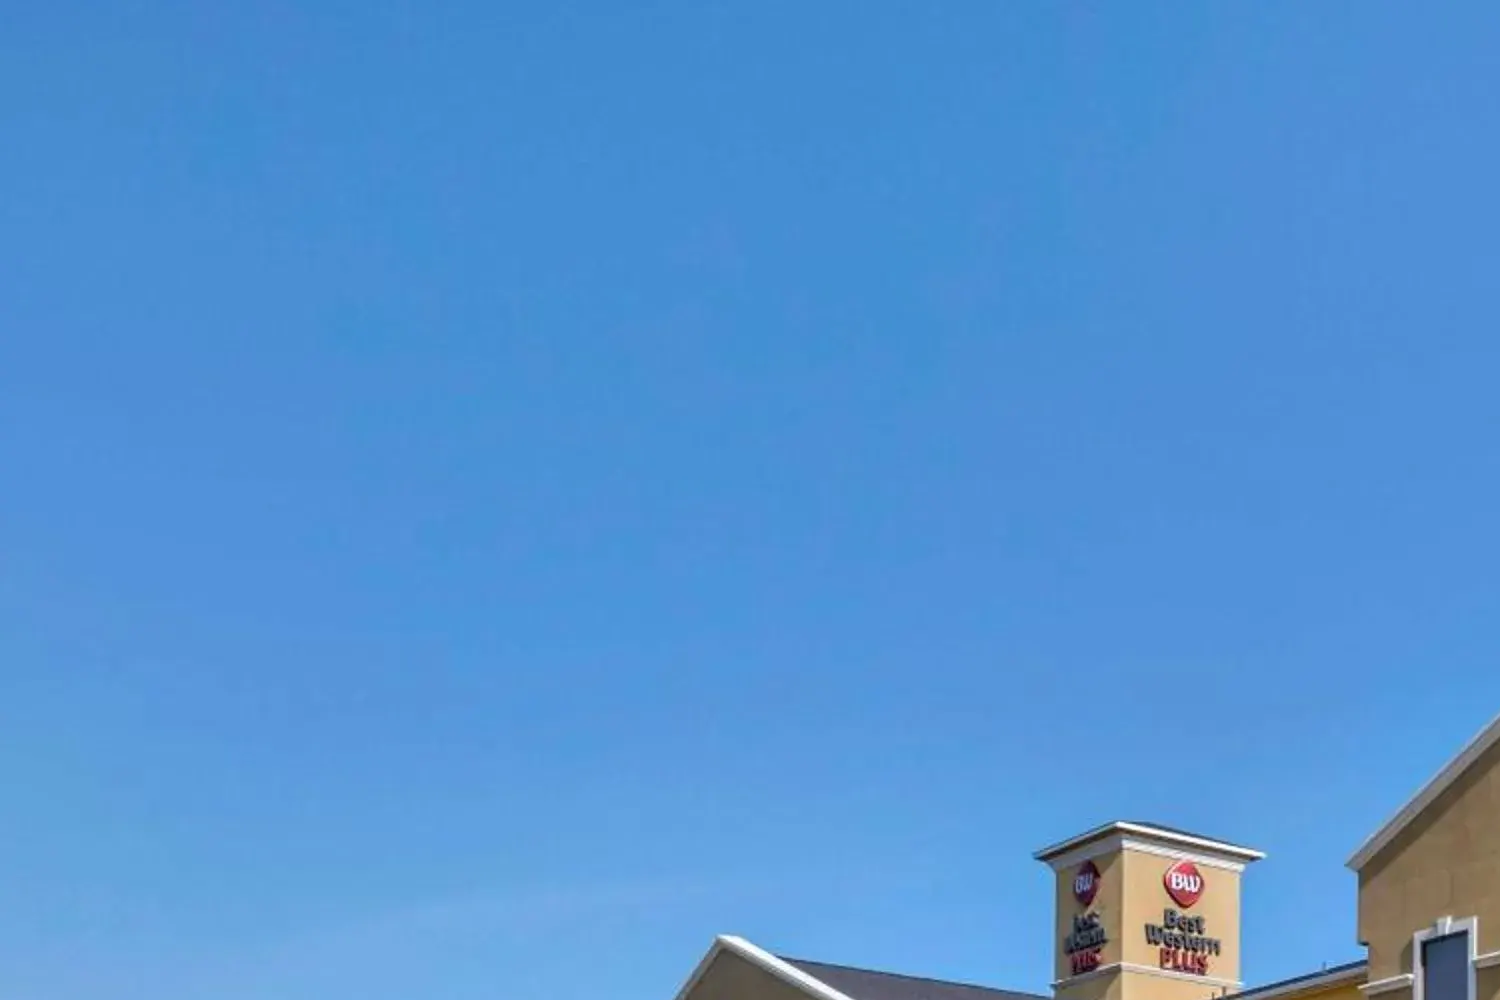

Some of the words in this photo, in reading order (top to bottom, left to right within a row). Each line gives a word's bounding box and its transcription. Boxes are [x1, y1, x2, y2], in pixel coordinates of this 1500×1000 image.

[1171, 872, 1200, 892] BW
[1163, 908, 1205, 935] Best
[1144, 923, 1221, 956] Western
[1160, 947, 1208, 976] PLUS
